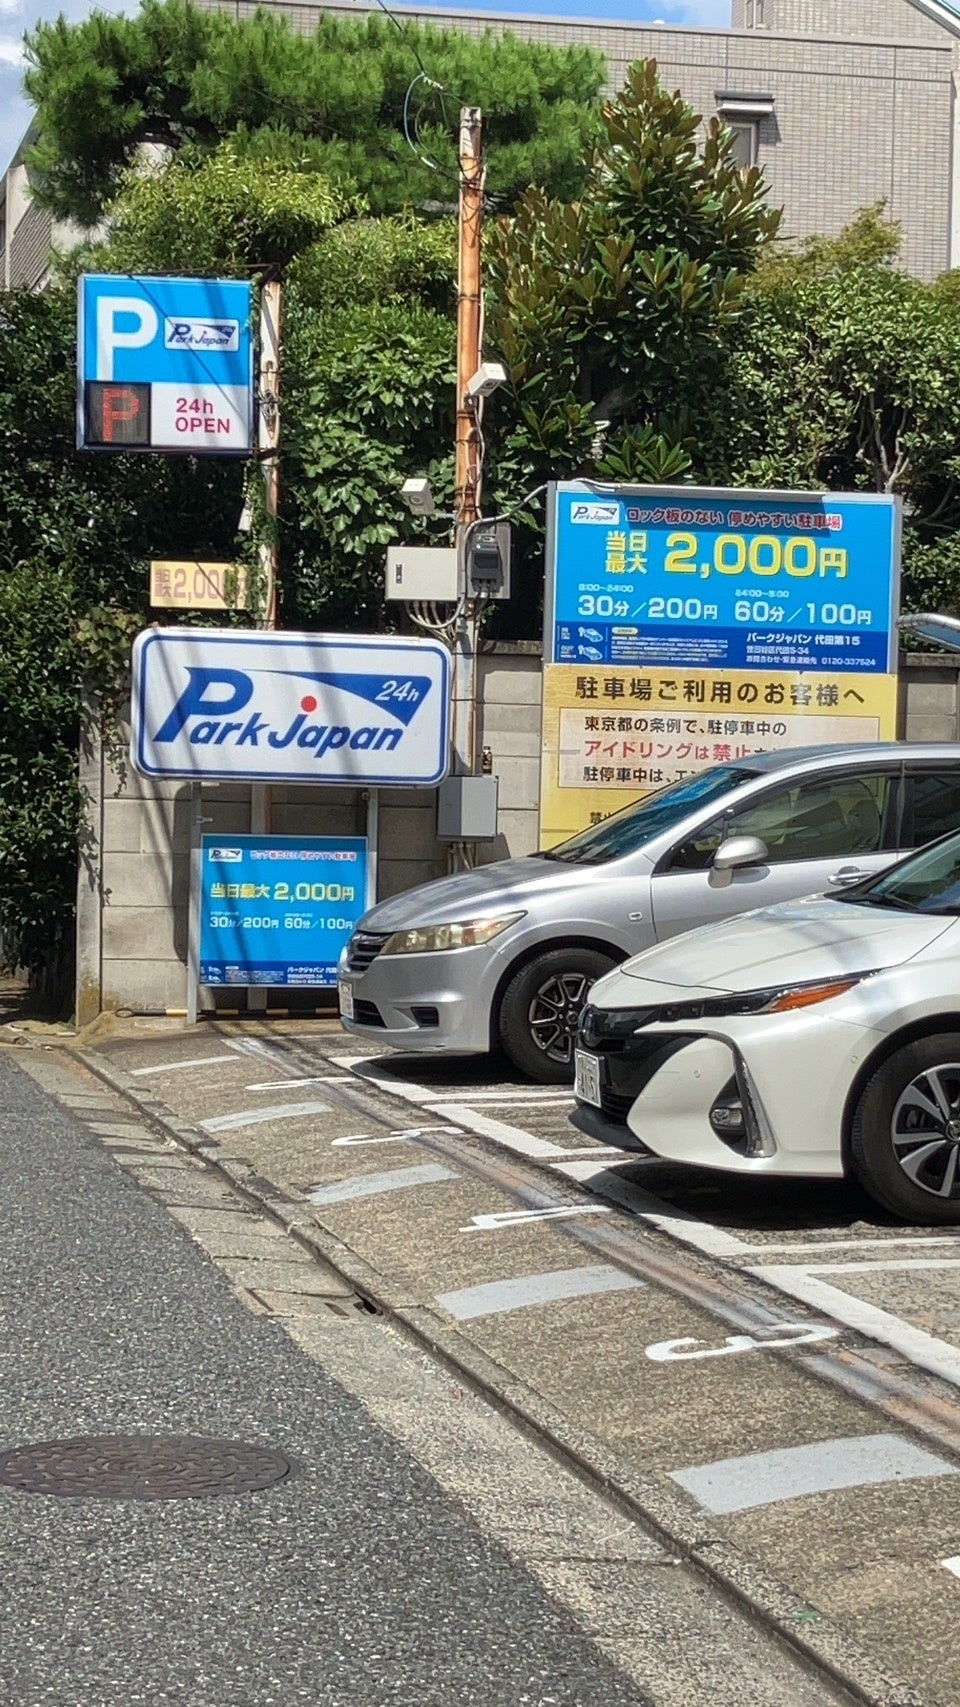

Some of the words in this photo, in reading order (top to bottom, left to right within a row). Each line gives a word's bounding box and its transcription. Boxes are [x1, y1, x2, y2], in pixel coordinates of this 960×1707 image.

[97, 296, 158, 381] P
[168, 323, 193, 344] Park
[195, 330, 229, 346] Japan
[103, 387, 139, 442] P
[176, 398, 213, 414] 24h
[175, 418, 230, 433] OPEN
[627, 508, 722, 524] ロック板のない
[728, 511, 841, 529] 停めやすい駐車場
[605, 531, 648, 553] 当日
[605, 554, 648, 575] 最大
[664, 533, 848, 579] 2,000円
[375, 680, 420, 702] 24h
[575, 676, 866, 706] 駐車場ご利用のお客様へ
[154, 666, 269, 746] Park
[268, 696, 405, 758] Japan
[584, 715, 788, 736] 東京都の条例で、駐停車中の
[210, 883, 271, 899] 当日最大
[273, 882, 355, 903] 2,000円
[645, 1322, 840, 1362] 3
